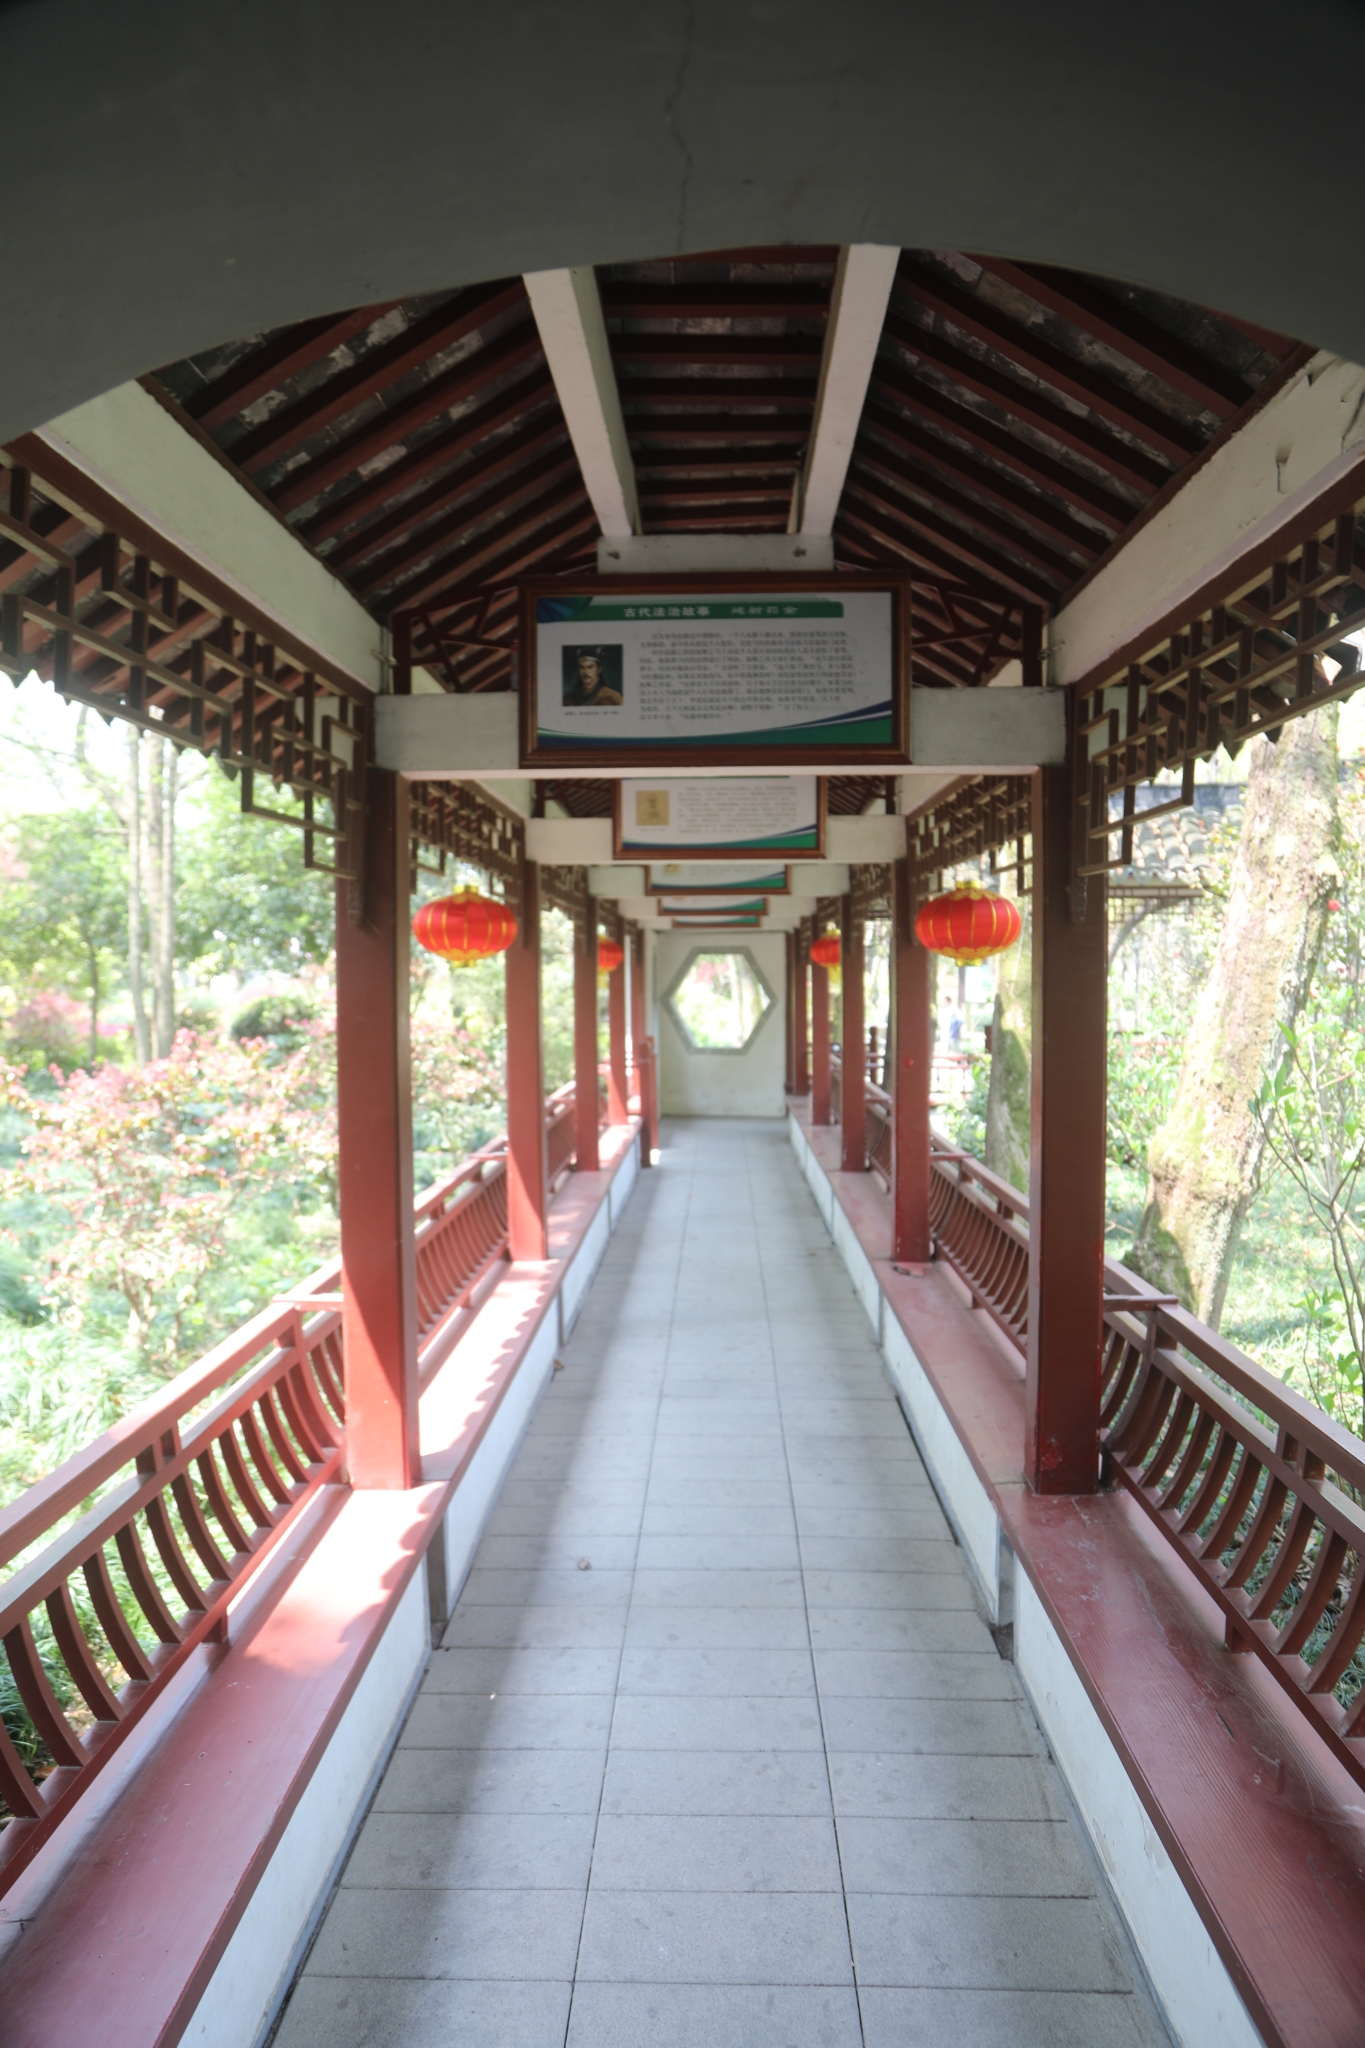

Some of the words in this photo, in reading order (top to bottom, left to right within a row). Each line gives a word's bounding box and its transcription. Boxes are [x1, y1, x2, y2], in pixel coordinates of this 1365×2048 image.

[624, 605, 711, 617] 古代法治故事
